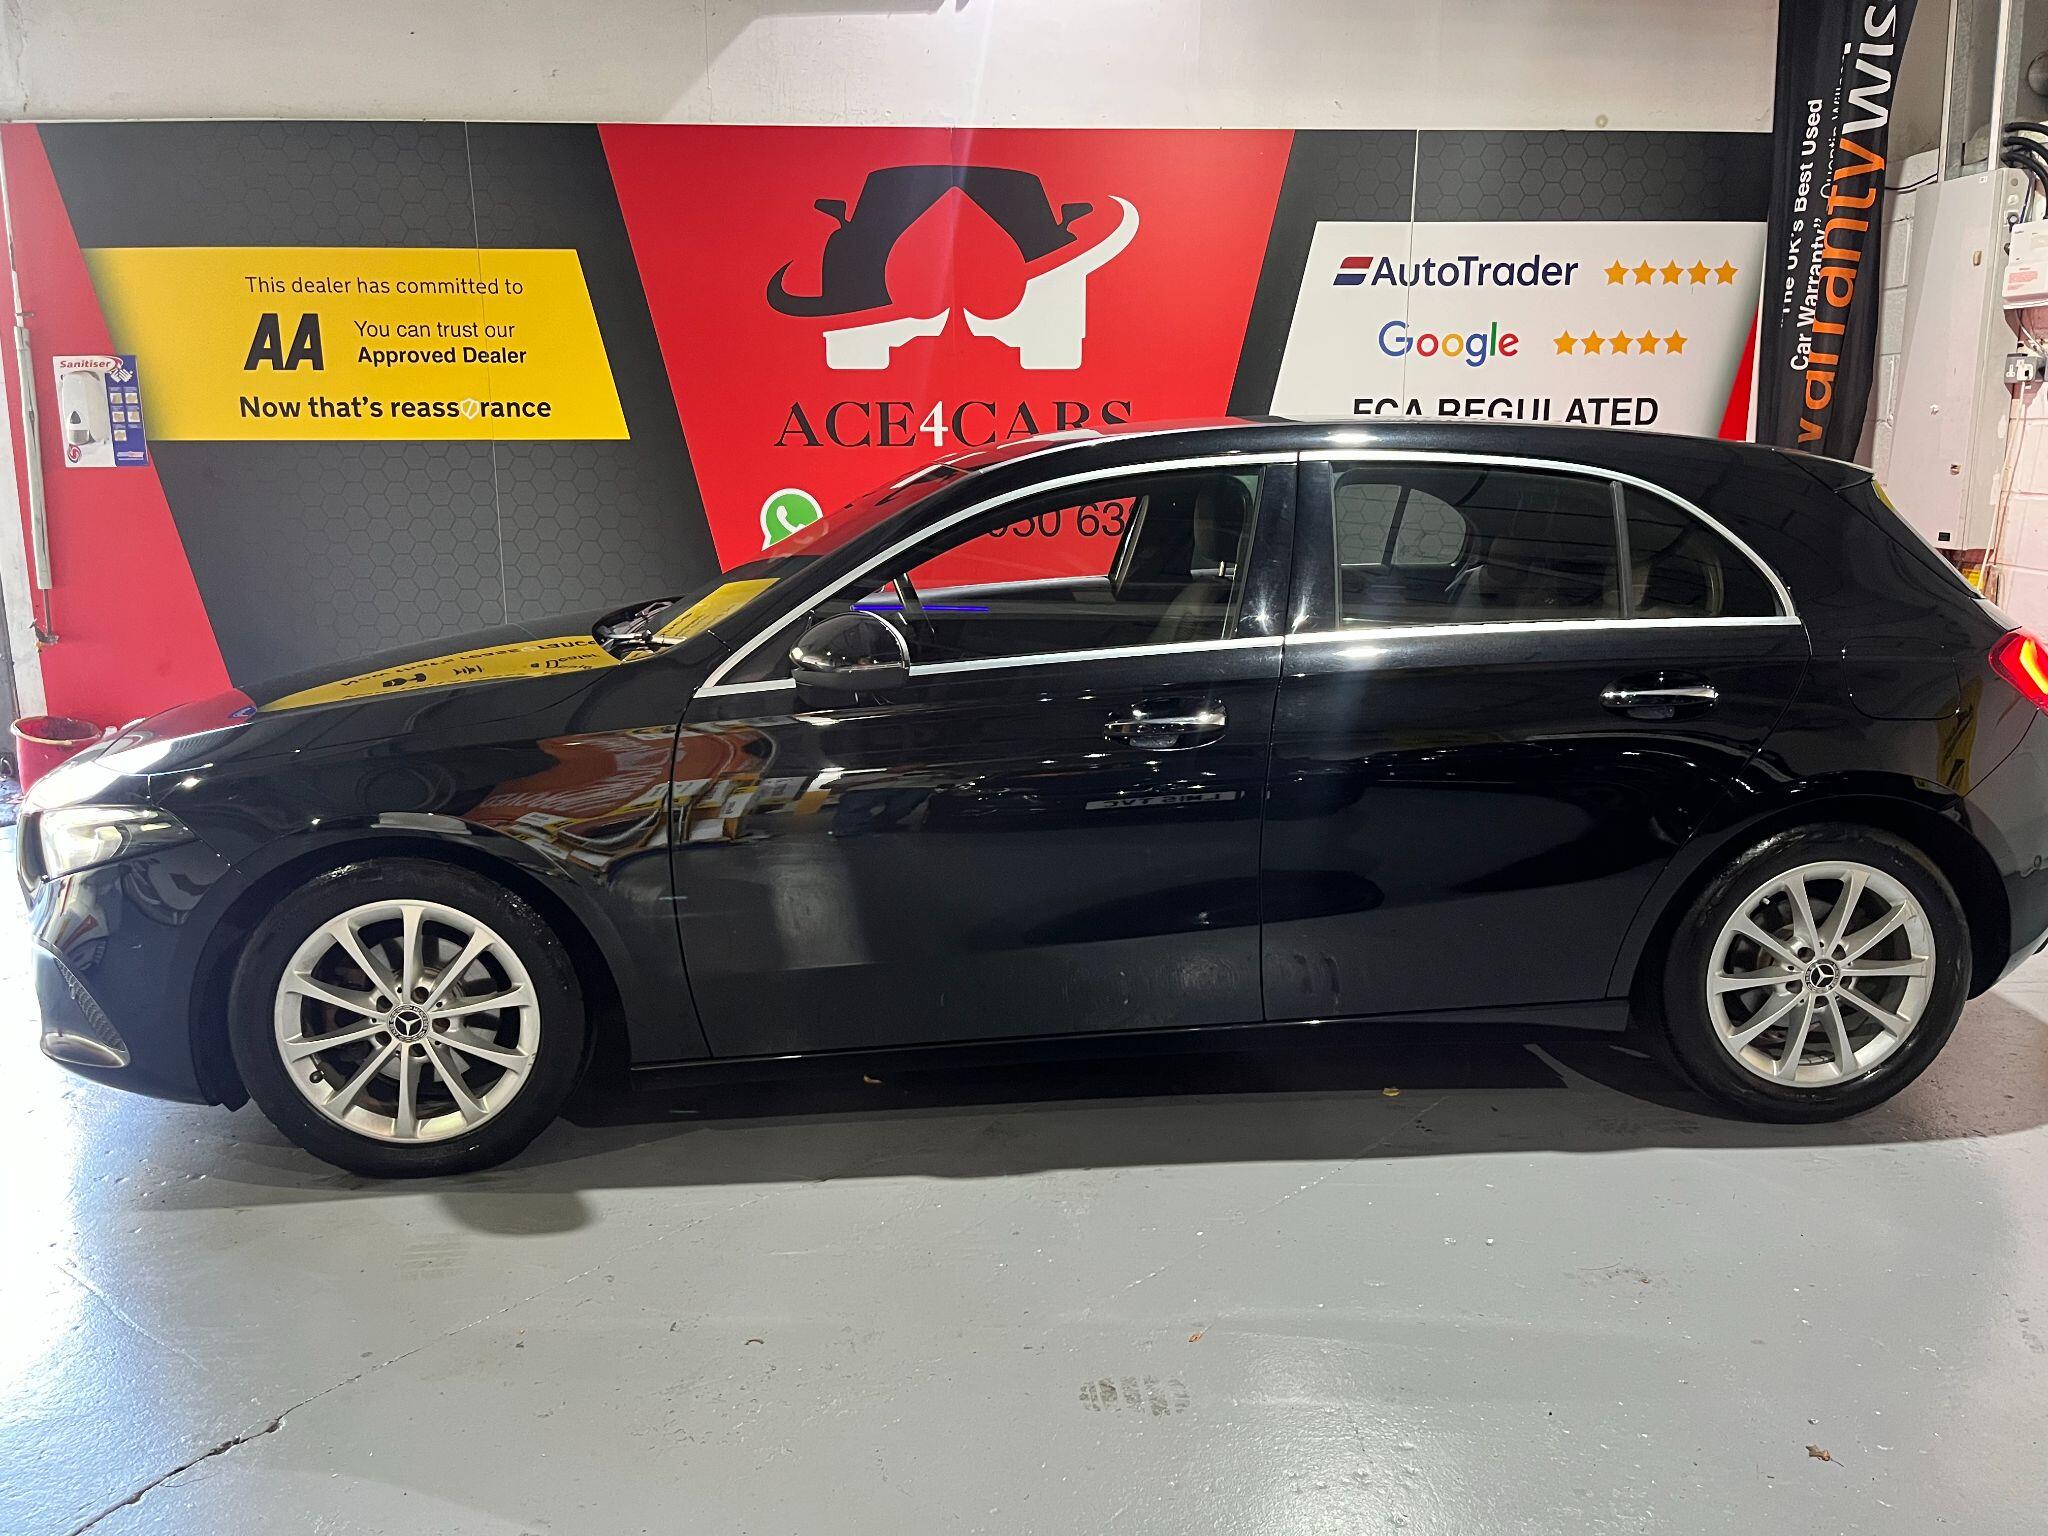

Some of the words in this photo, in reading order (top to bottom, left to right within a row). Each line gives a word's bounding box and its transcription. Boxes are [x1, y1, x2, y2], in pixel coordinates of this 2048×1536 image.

[1801, 99, 1823, 156] Used
[1794, 161, 1814, 213] Best
[245, 276, 285, 293] This
[291, 276, 351, 293] dealer
[357, 277, 390, 293] has
[396, 277, 499, 294] committed
[505, 278, 523, 294] to
[1371, 254, 1578, 286] AutoTrader
[243, 313, 325, 370] AA
[354, 320, 390, 337] You
[396, 323, 431, 337] can
[437, 322, 478, 337] trust
[485, 324, 515, 337] our
[1378, 320, 1519, 368] Google
[60, 359, 111, 369] Sanitiser
[358, 346, 456, 367] Approved
[462, 346, 527, 363] Dealer
[1790, 333, 1812, 371] Car
[240, 396, 301, 417] Now
[1438, 397, 1659, 426] REGULATED
[1077, 501, 1134, 537] 63
